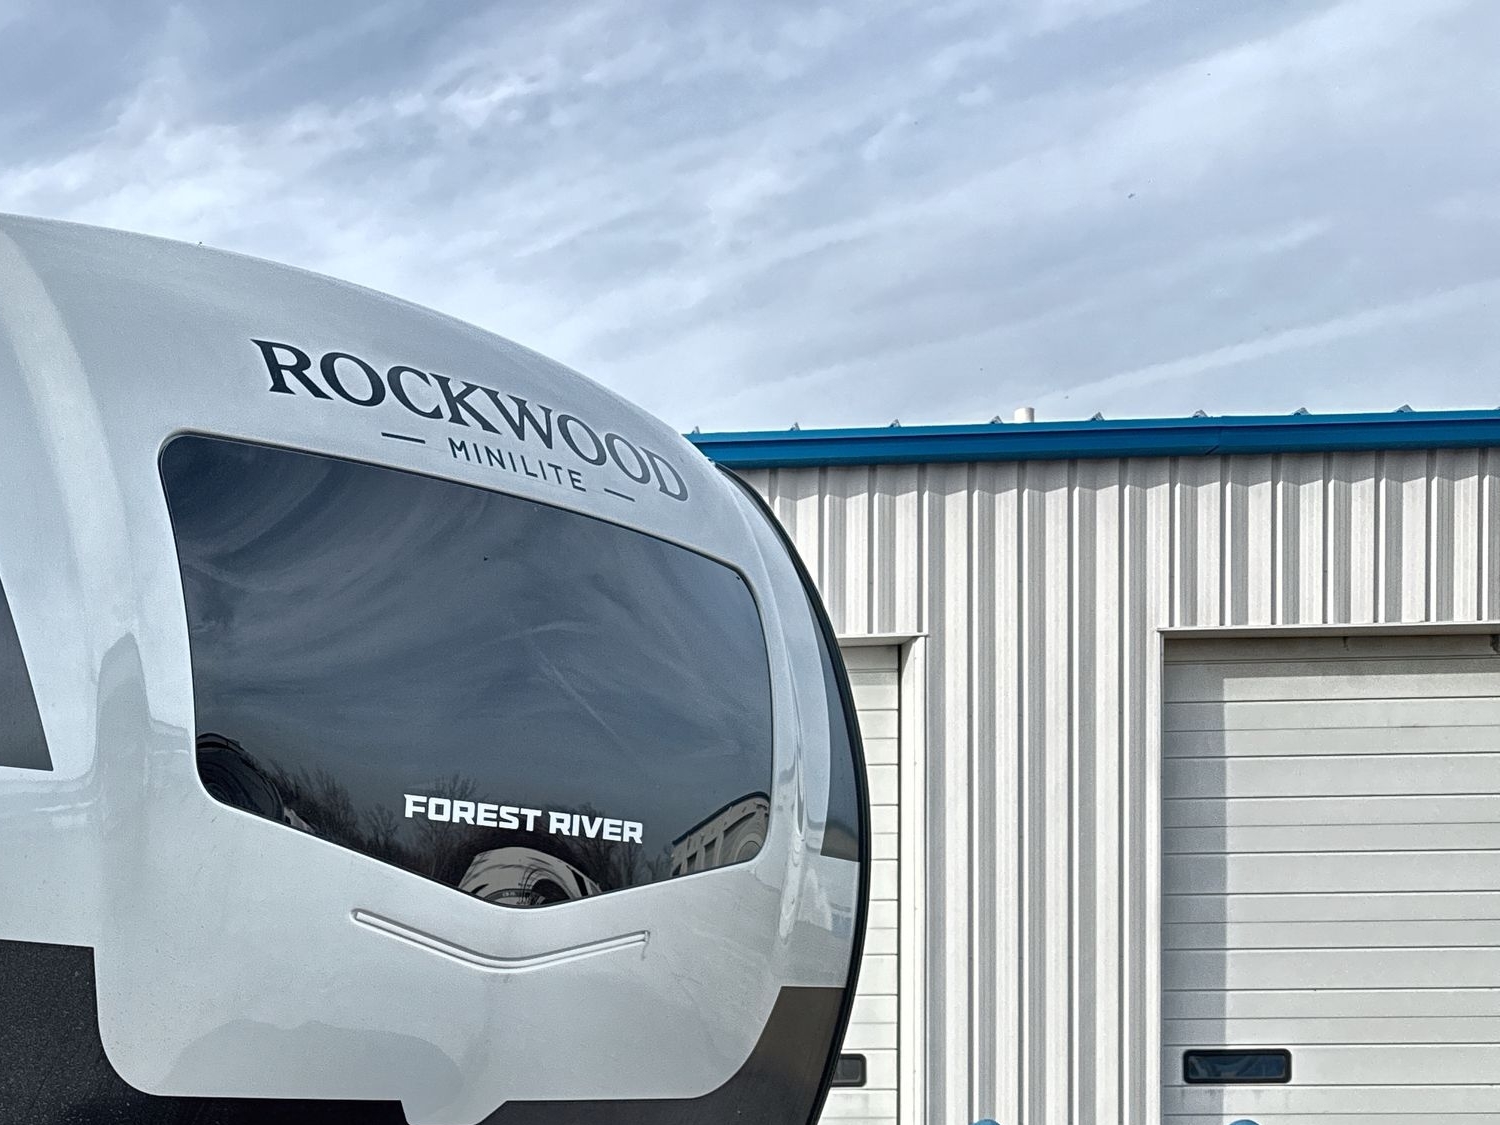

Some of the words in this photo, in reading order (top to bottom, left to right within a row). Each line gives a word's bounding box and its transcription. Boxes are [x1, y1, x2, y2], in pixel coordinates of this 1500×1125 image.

[250, 338, 689, 502] ROCKWOOD
[447, 436, 587, 492] MINILITE
[403, 793, 543, 833] FOREST
[548, 811, 644, 844] RIVER
